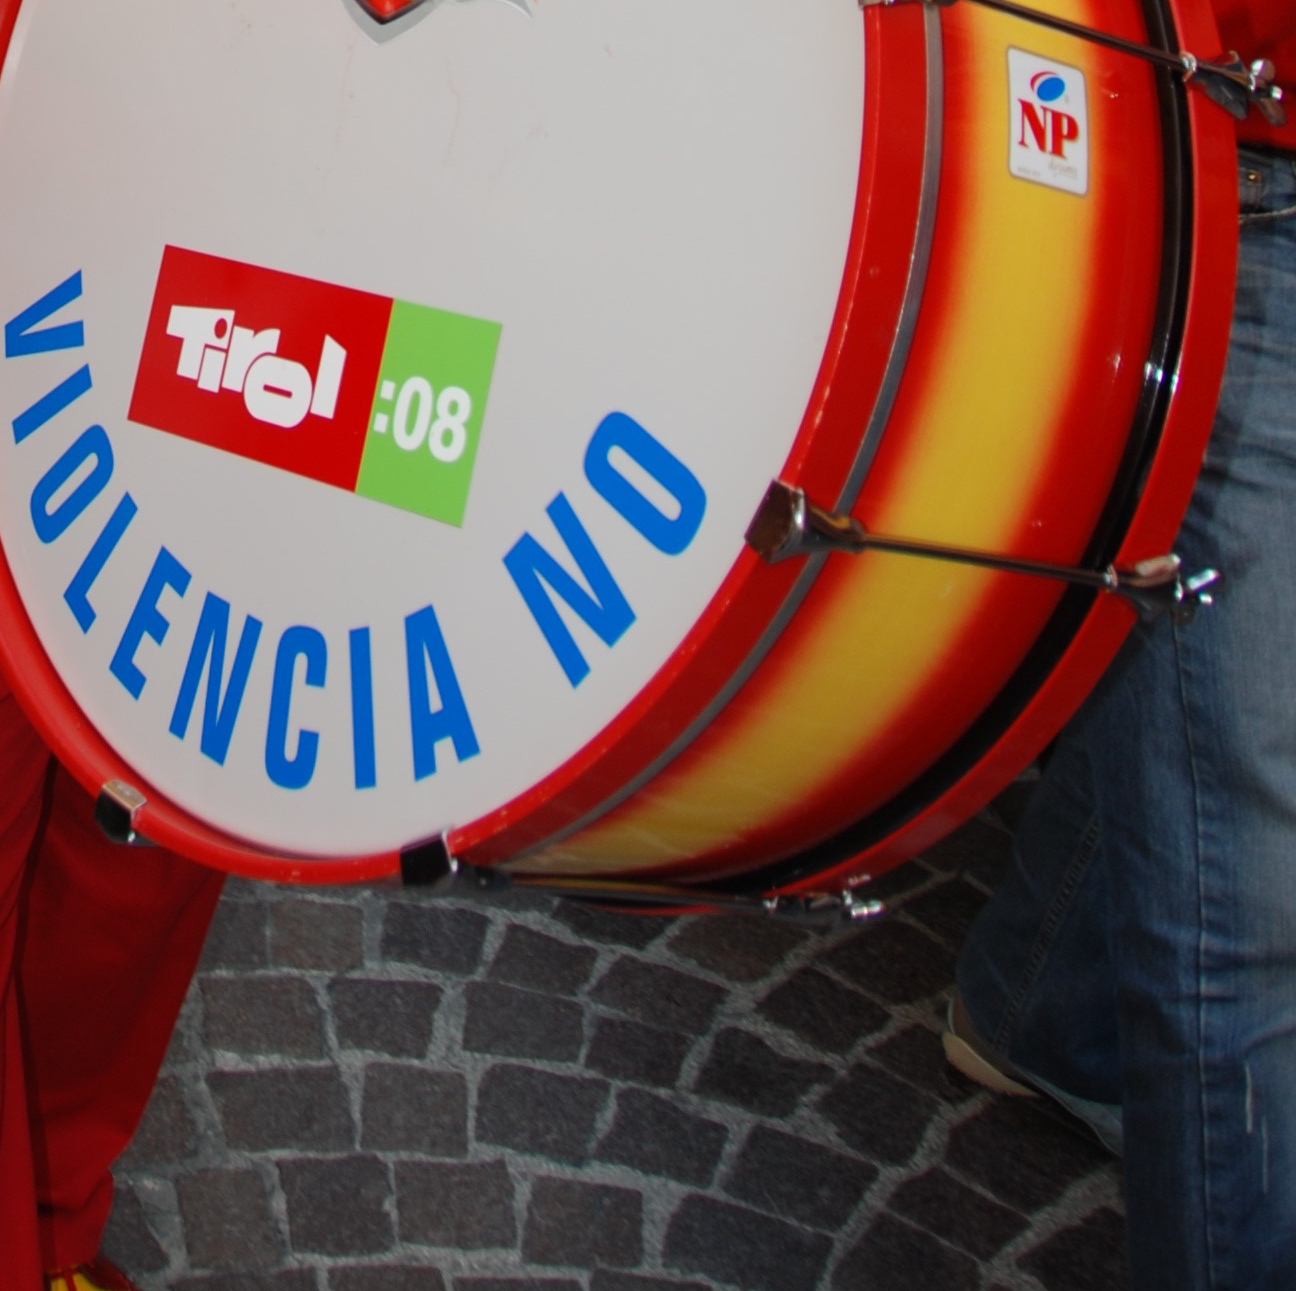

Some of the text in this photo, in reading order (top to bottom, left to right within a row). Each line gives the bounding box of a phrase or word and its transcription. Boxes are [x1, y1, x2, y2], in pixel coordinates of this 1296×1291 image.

[1018, 98, 1080, 160] NP
[166, 304, 472, 463] Tirol :08
[4, 270, 708, 791] VIOLENCIA NO
